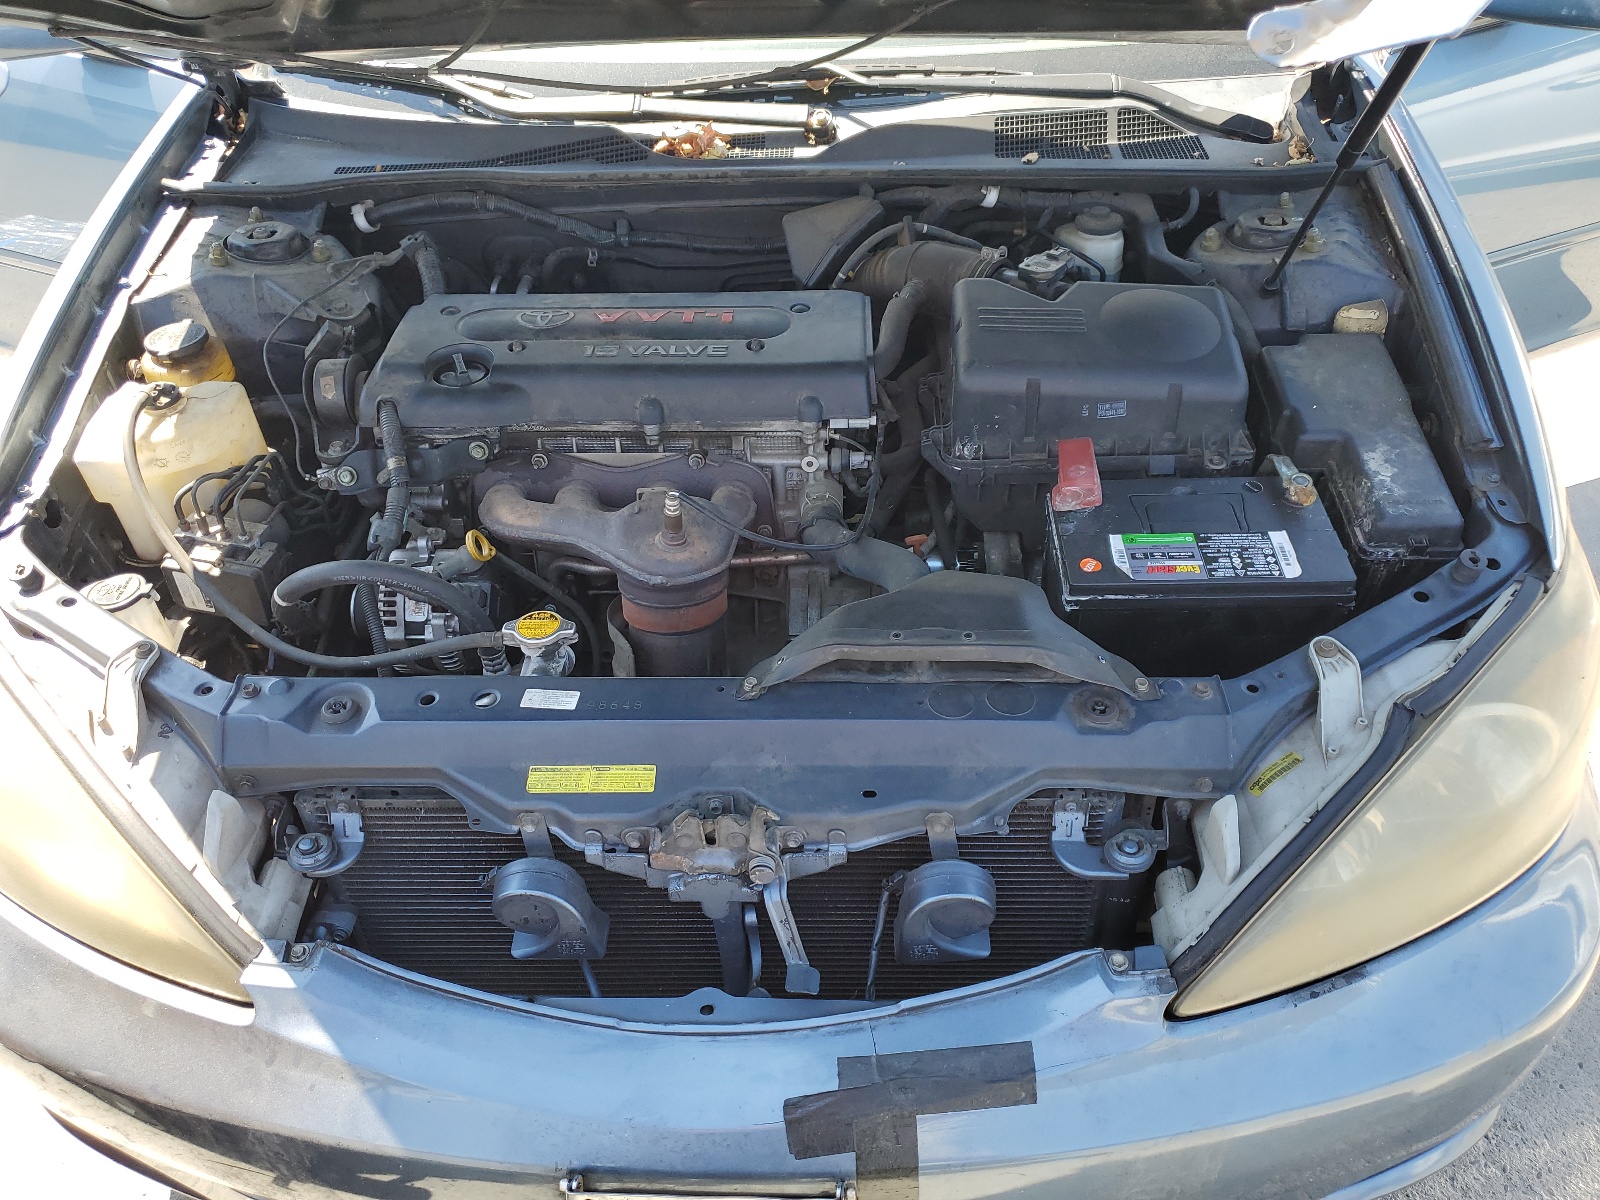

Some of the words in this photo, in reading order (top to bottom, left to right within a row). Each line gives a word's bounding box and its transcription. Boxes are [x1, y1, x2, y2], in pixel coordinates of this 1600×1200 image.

[594, 310, 734, 323] VVT-i
[585, 345, 620, 357] 16
[626, 345, 728, 357] VALVE
